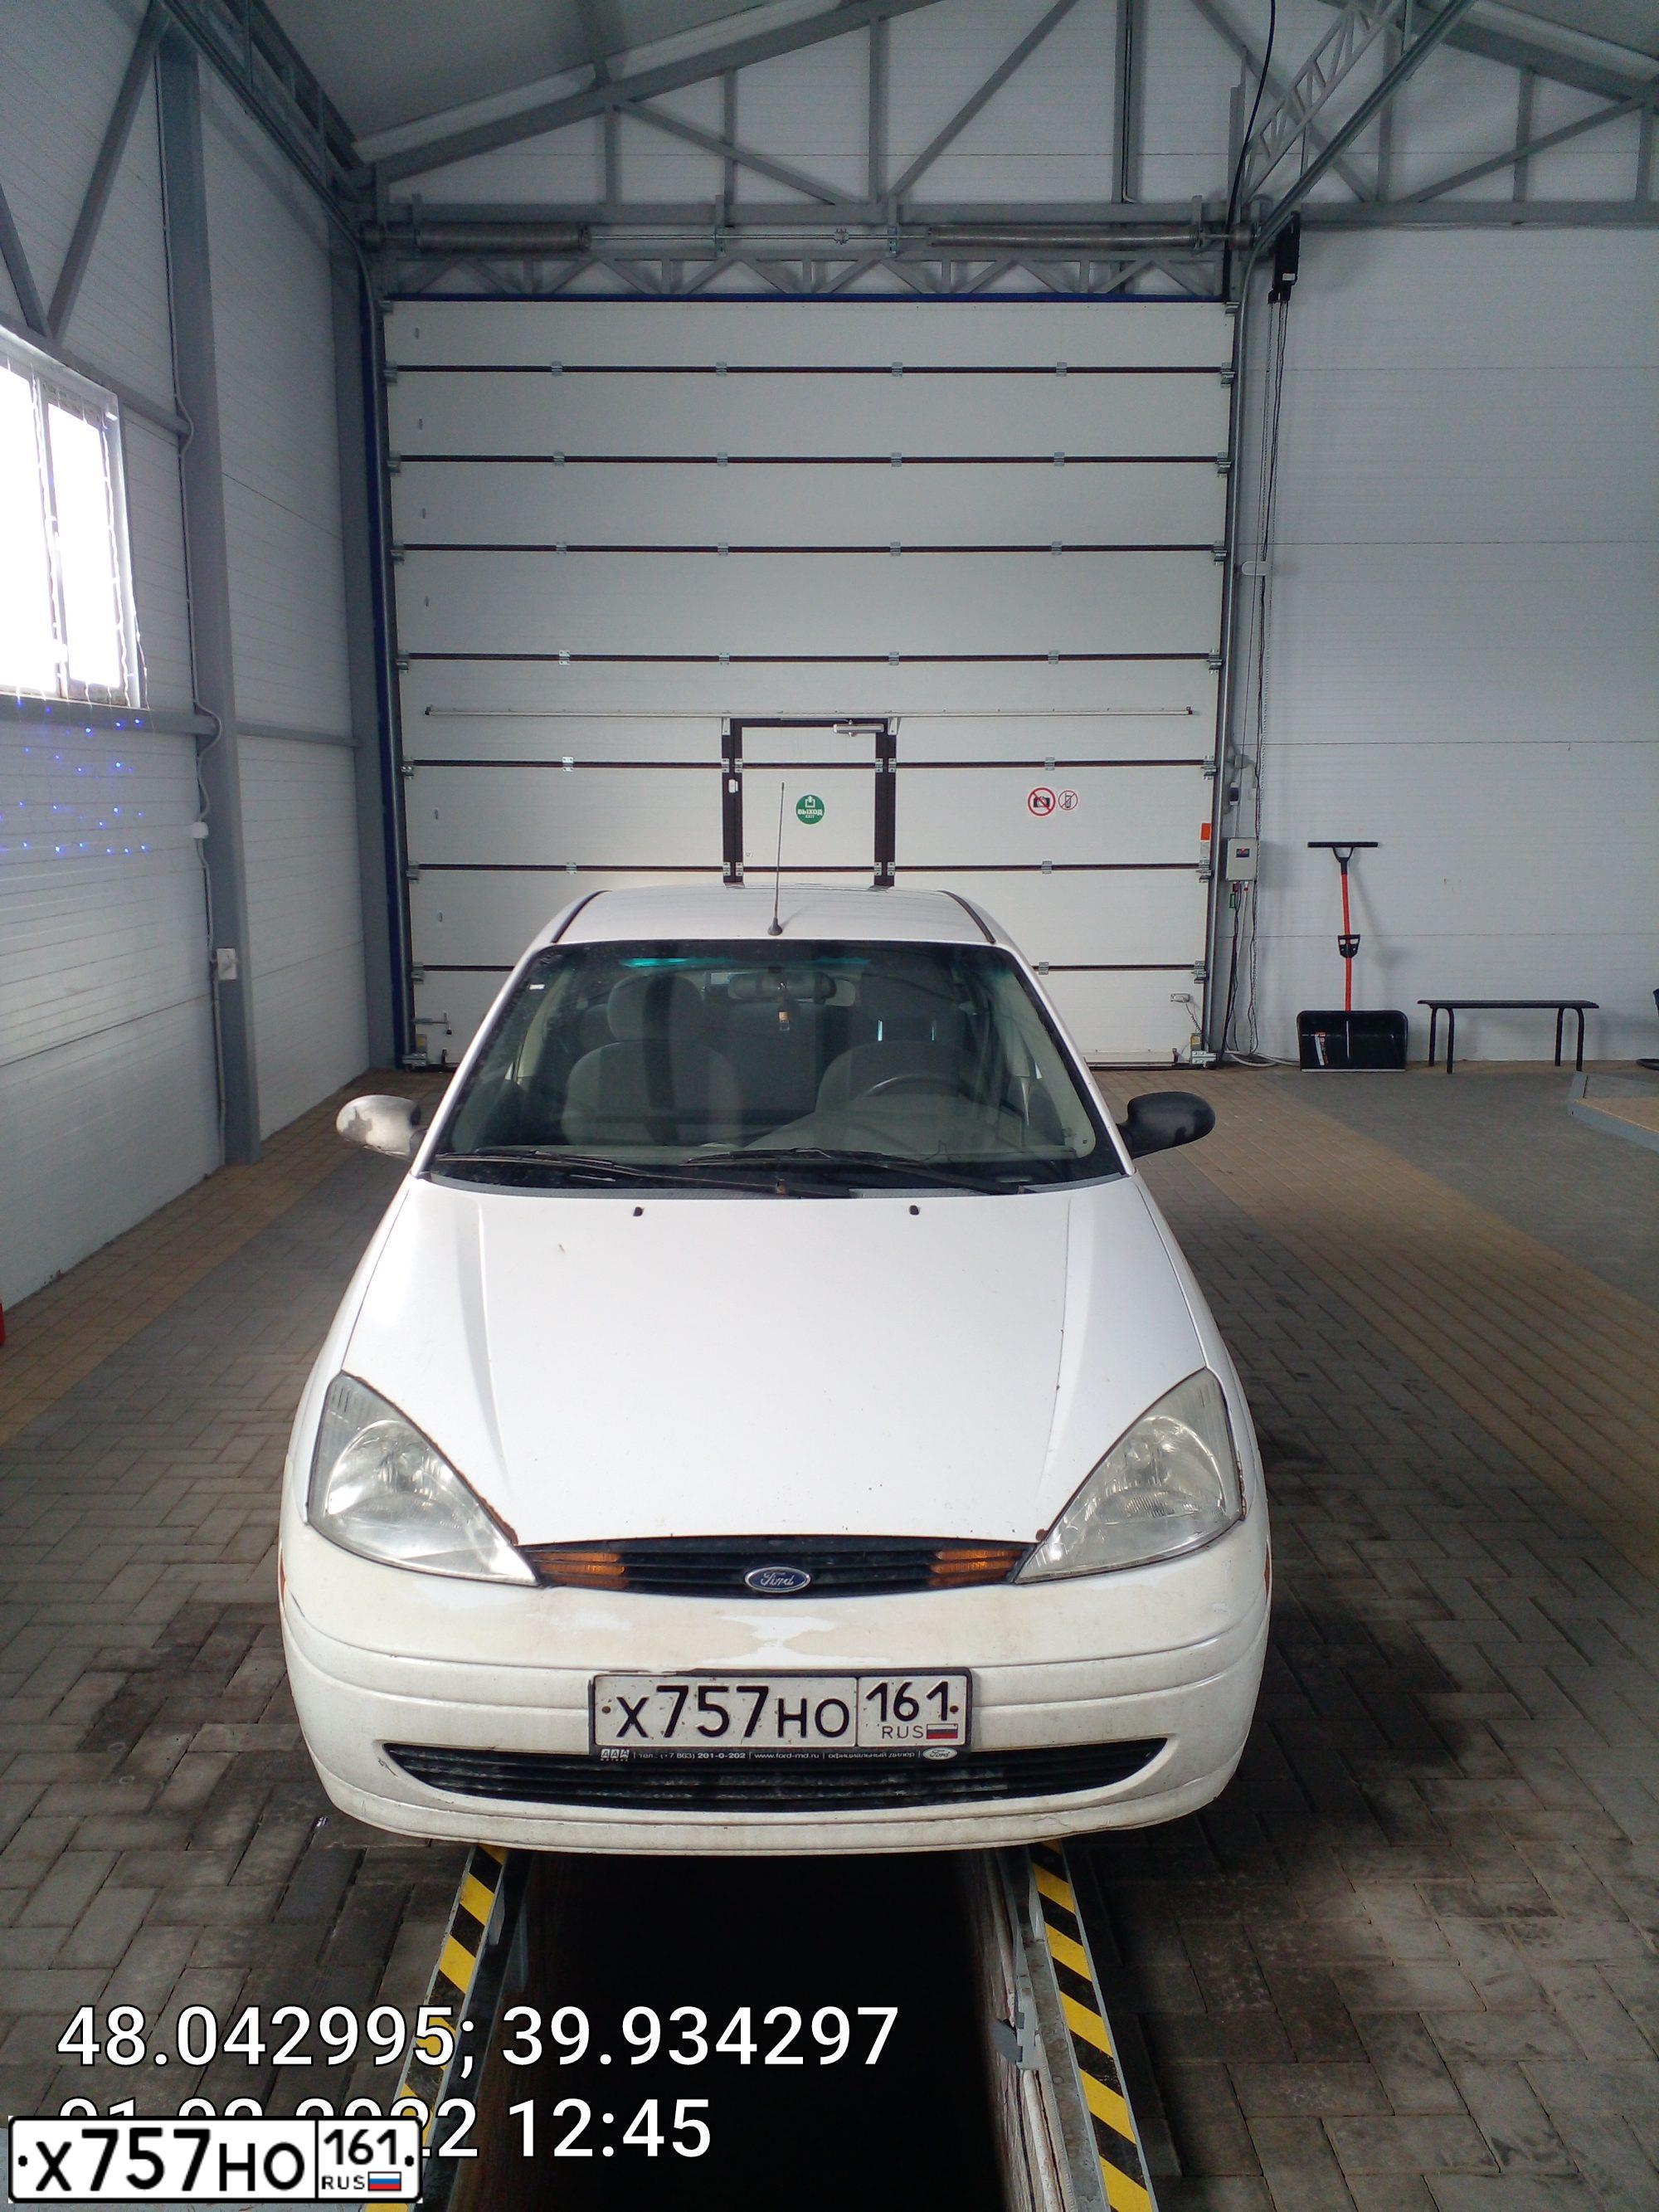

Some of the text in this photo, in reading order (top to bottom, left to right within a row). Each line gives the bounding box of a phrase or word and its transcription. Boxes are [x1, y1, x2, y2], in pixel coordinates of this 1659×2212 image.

[760, 1571, 795, 1586] Ford
[865, 1680, 949, 1722] 161
[881, 1725, 924, 1740] RUS
[828, 1751, 888, 1760] официальный
[929, 1748, 951, 1759] Ford
